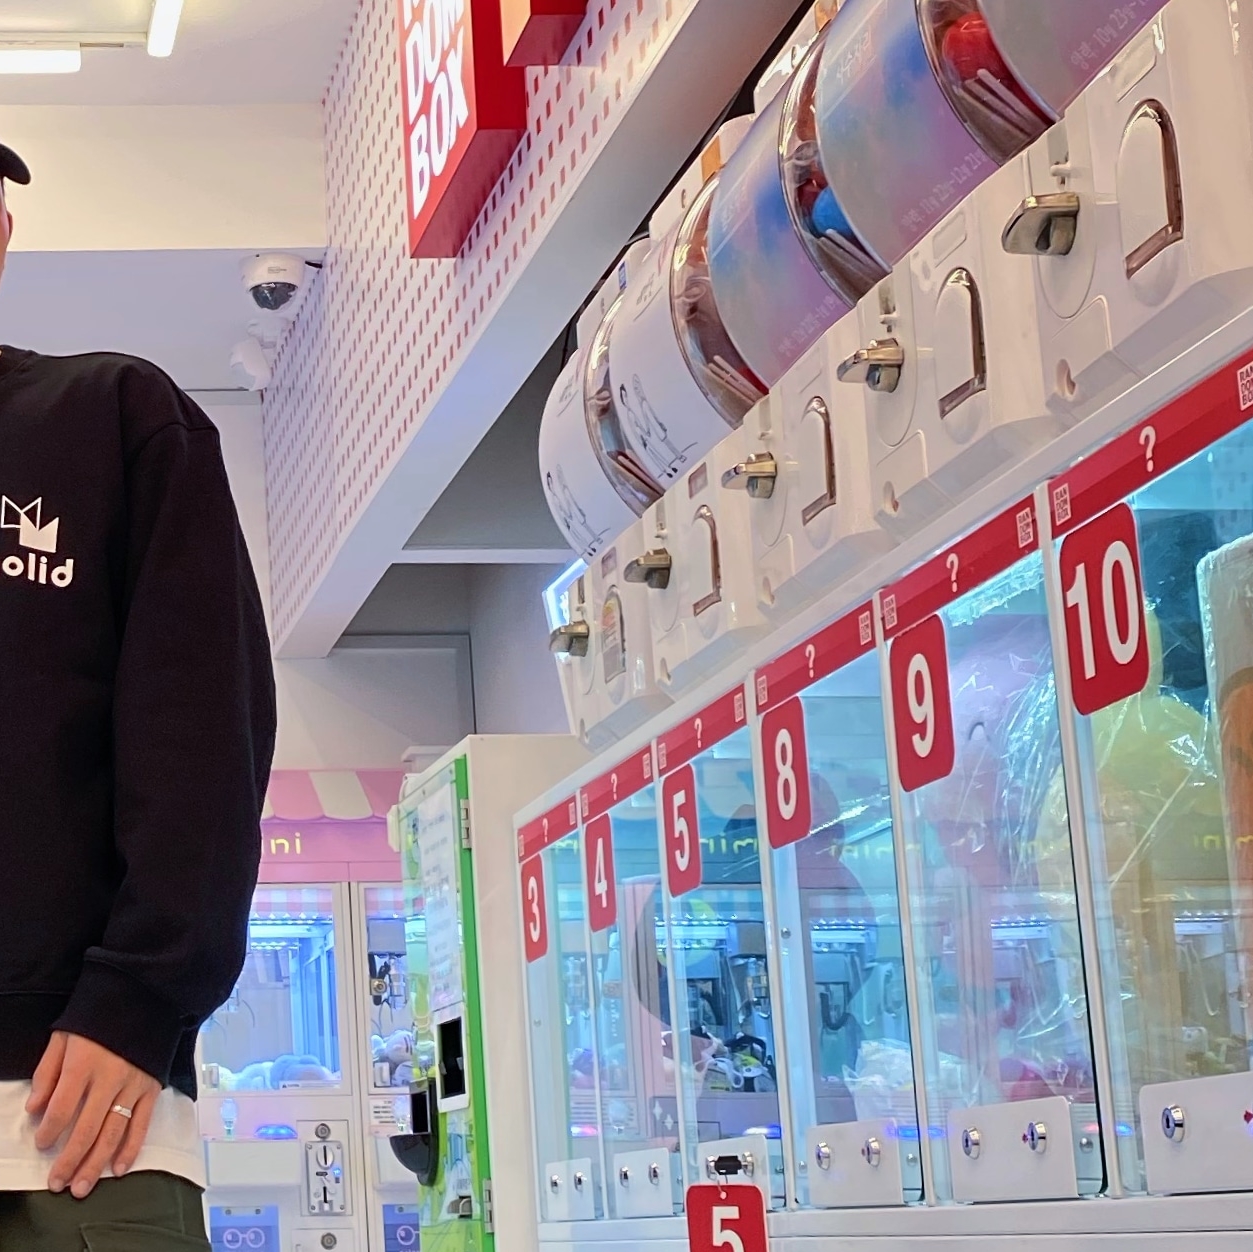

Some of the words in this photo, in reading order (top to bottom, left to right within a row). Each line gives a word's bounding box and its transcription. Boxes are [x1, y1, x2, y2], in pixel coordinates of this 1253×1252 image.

[410, 26, 469, 220] BOX
[1066, 540, 1140, 680] 10
[907, 653, 935, 758] 9
[775, 728, 797, 820] 8
[269, 832, 302, 855] ni
[595, 838, 608, 908] 4
[673, 790, 690, 871] 5
[527, 876, 540, 942] 3
